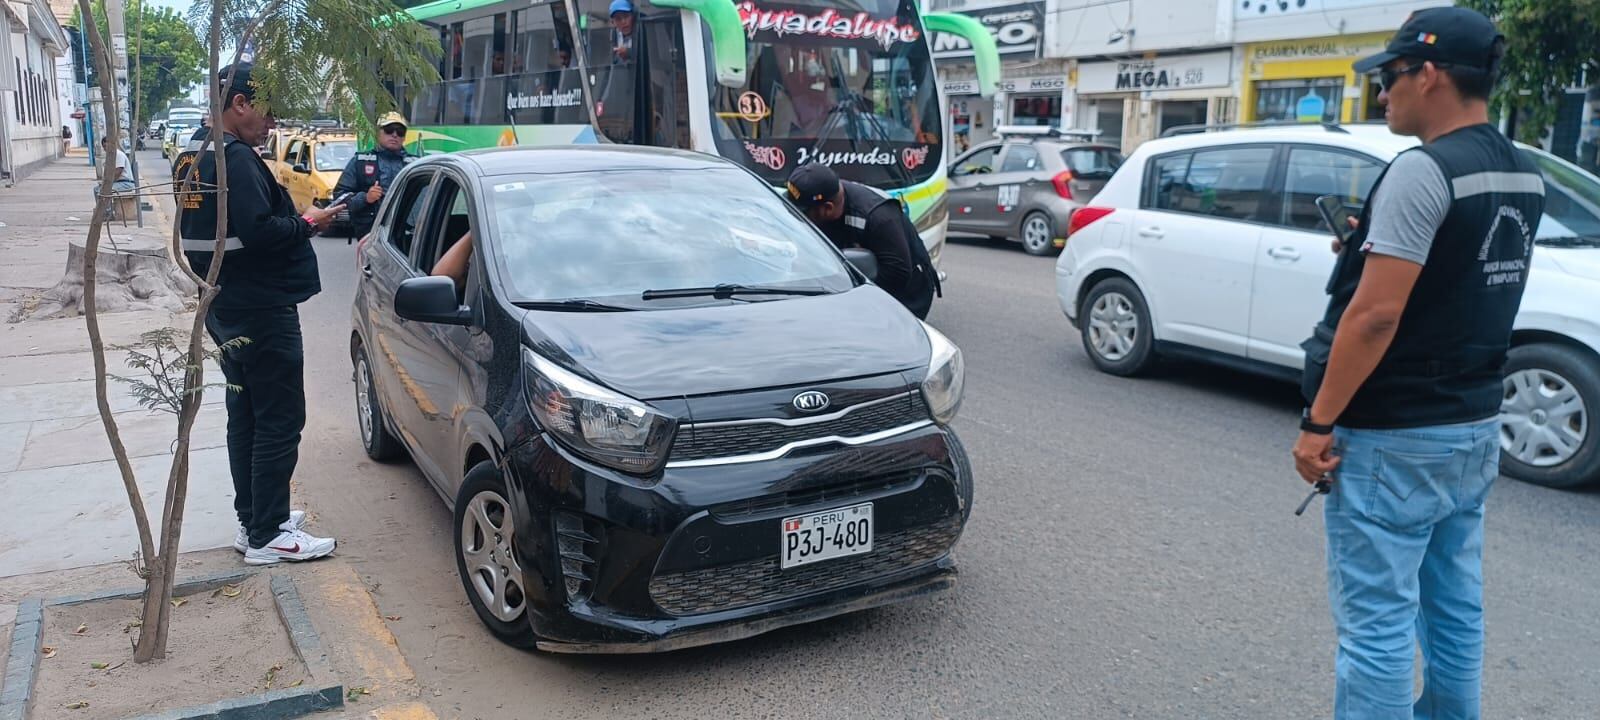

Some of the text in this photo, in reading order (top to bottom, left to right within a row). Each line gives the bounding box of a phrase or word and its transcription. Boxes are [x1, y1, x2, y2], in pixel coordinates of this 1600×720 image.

[934, 22, 1037, 51] MO
[1255, 45, 1298, 59] EXAMEN
[1302, 42, 1340, 56] VISUAL
[1116, 70, 1169, 89] MEGA
[507, 92, 518, 110] Que
[518, 91, 529, 109] bien
[530, 95, 540, 108] nos
[540, 90, 553, 107] hace
[743, 95, 762, 114] 31
[797, 146, 897, 167] Hyundai
[799, 394, 825, 408] KIA
[812, 511, 845, 526] PERU
[787, 518, 869, 560] P3J-480
